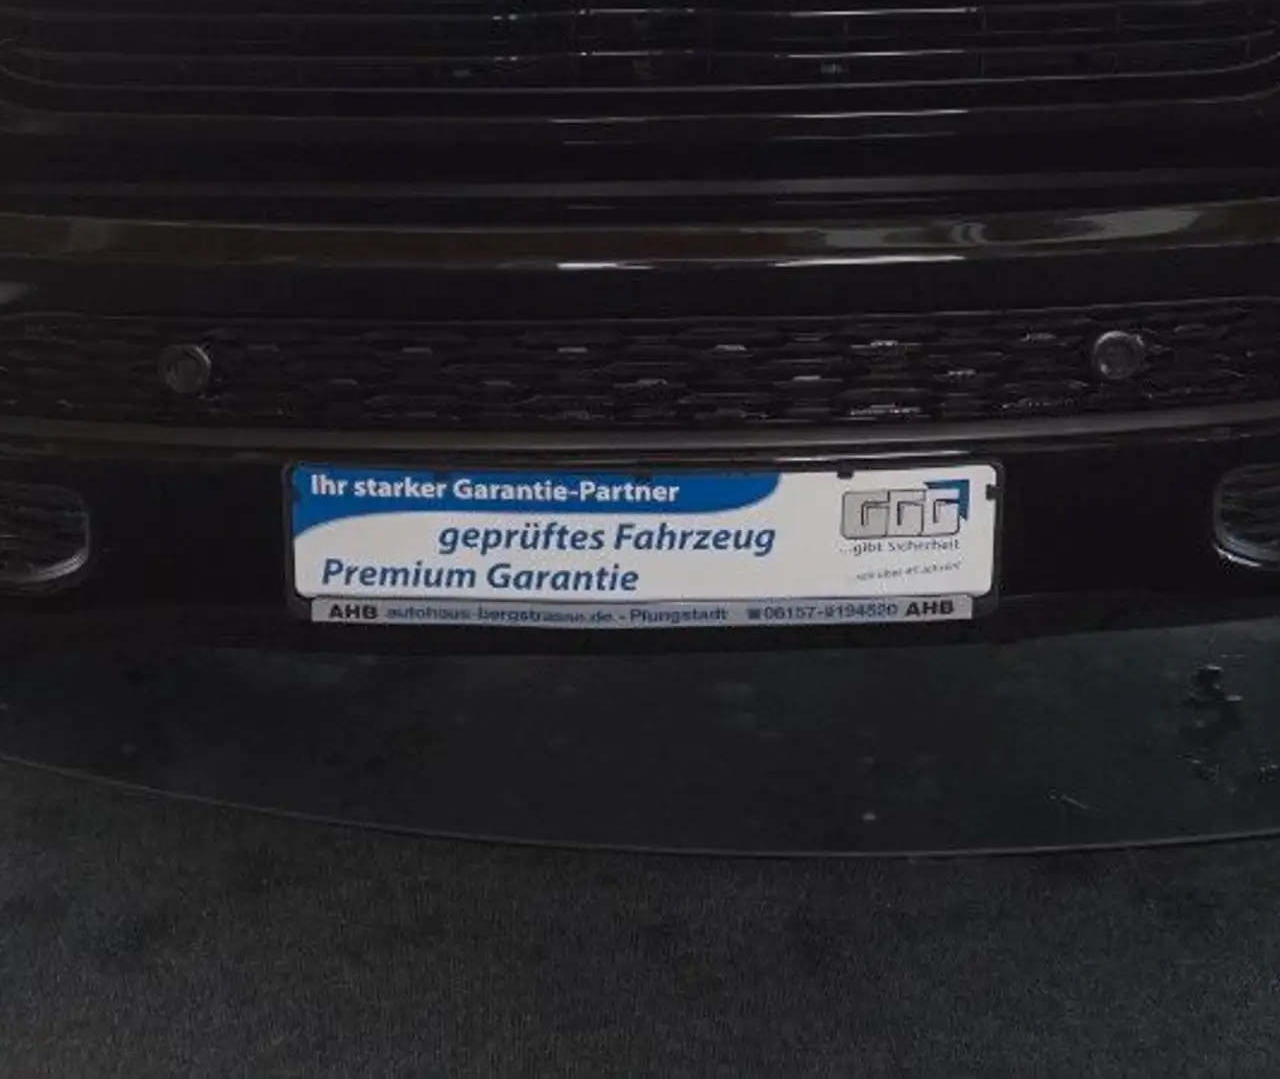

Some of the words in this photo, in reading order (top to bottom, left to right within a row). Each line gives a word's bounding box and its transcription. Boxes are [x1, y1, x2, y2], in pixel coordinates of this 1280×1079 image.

[311, 474, 348, 495] Ihr
[354, 477, 446, 499] starker
[453, 478, 680, 502] Garantie-Partner
[438, 522, 605, 556] geprüftes
[614, 522, 776, 557] Fahrzeug
[887, 538, 961, 553] Sicherheit
[322, 558, 477, 589] Premium
[486, 563, 640, 591] Garantie
[329, 603, 378, 620] AHB
[629, 607, 728, 623] Pfungstadt
[905, 599, 954, 617] AHB
